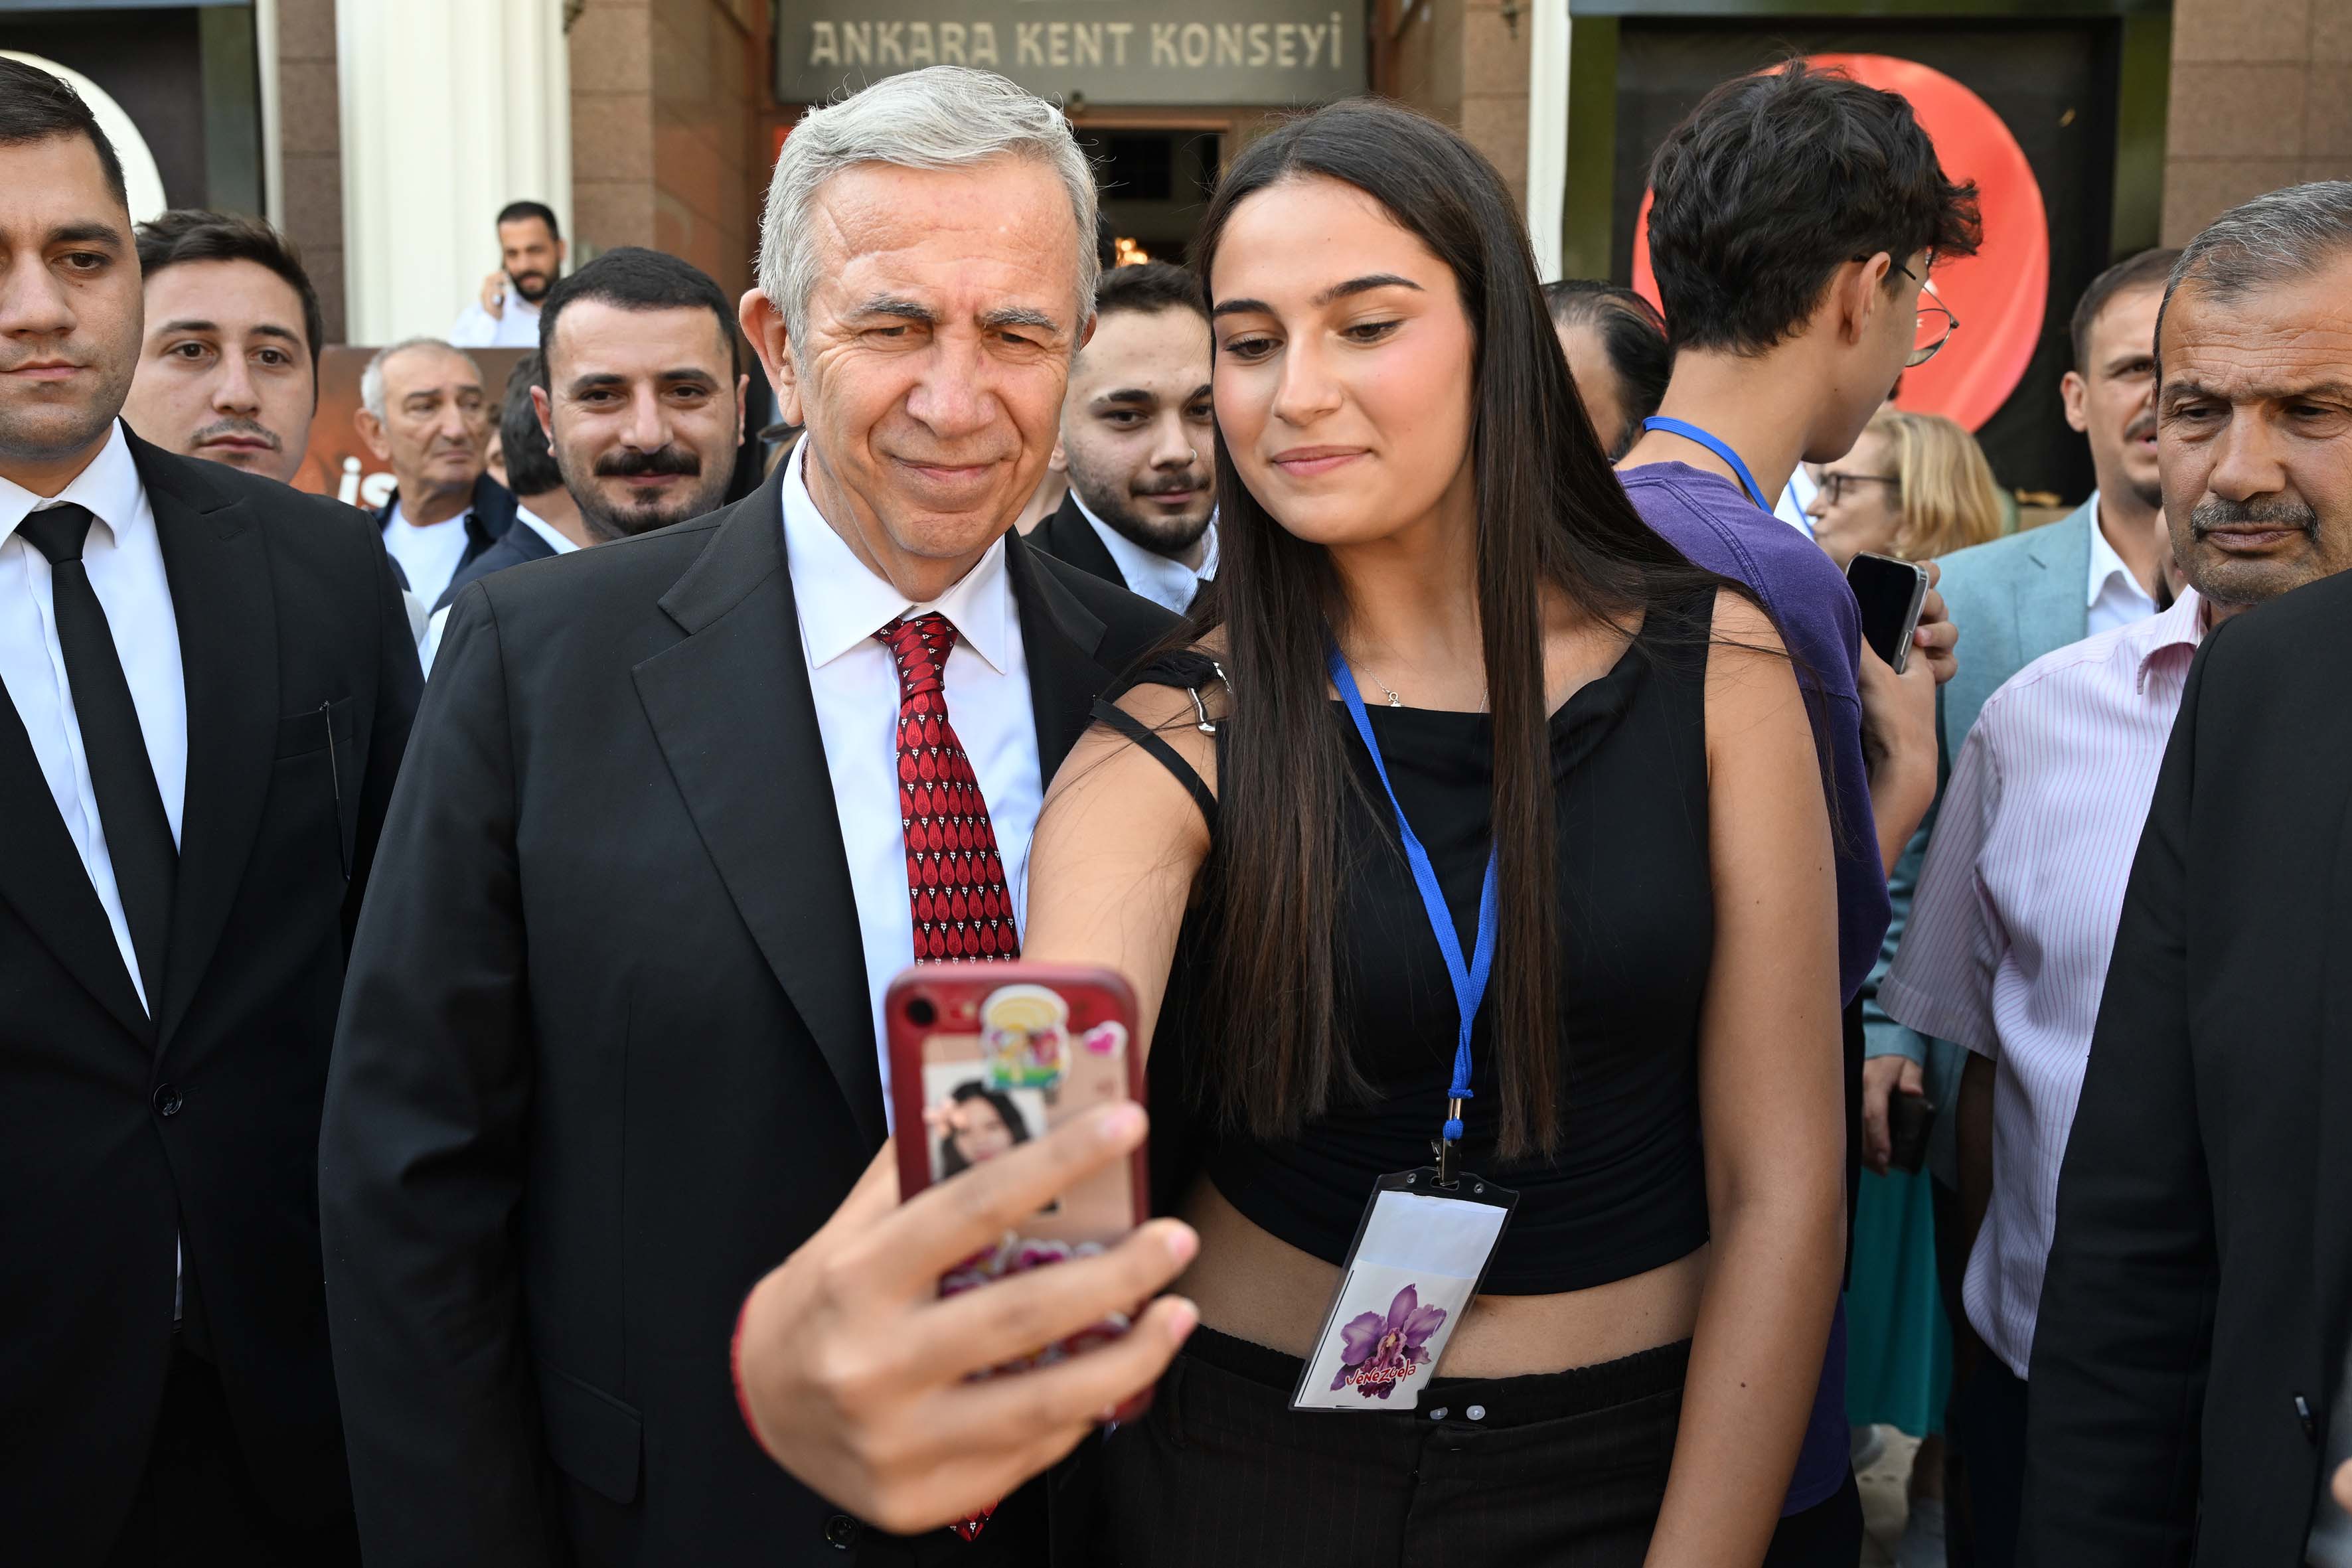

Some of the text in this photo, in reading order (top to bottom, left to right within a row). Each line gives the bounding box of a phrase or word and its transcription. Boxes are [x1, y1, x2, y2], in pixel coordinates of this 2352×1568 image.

[809, 11, 1342, 67] ANKARA KENT KONSEYİ
